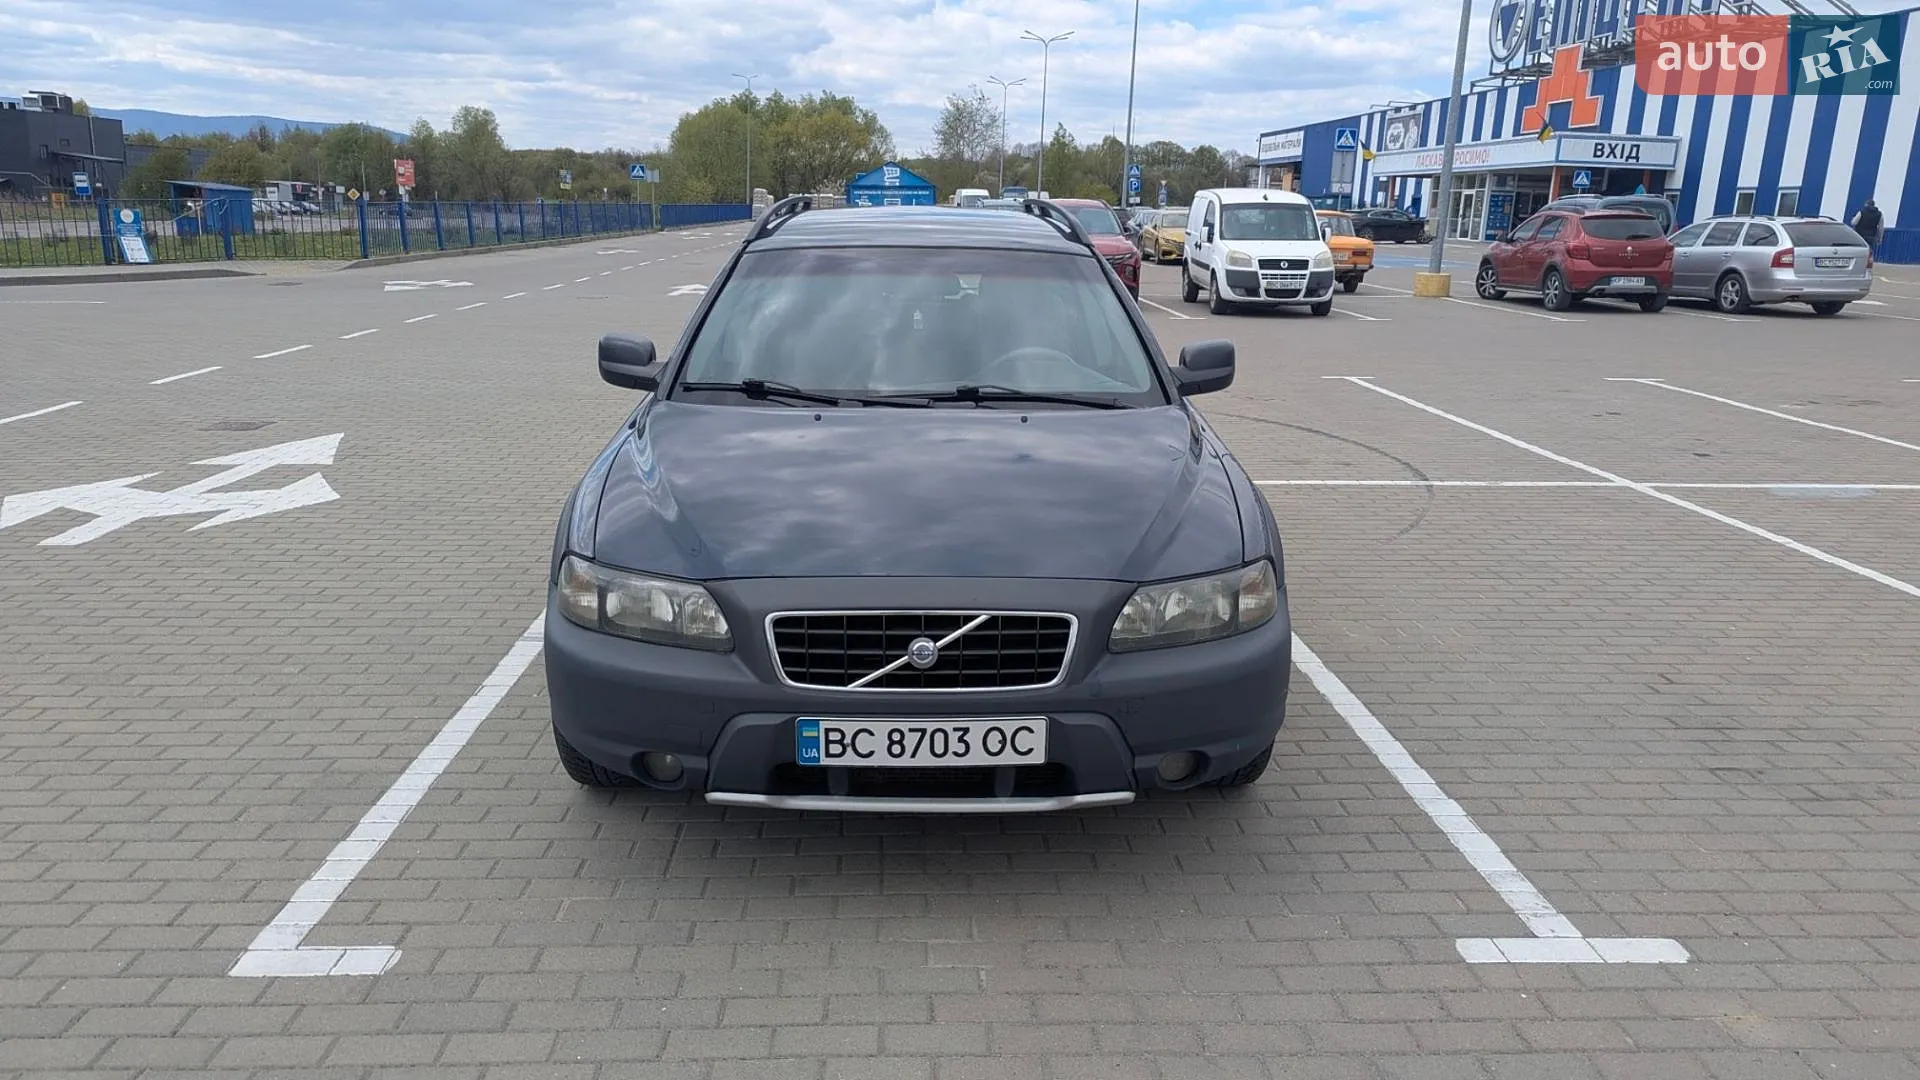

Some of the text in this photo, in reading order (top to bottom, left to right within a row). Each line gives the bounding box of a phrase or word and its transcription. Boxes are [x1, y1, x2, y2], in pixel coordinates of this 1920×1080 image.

[1415, 149, 1490, 168] ЛАСКАВ РОСИМО!
[1592, 142, 1641, 162] ВХІД
[1131, 181, 1138, 191] P
[824, 725, 1036, 759] BC 8703 OC
[802, 748, 818, 758] UA
